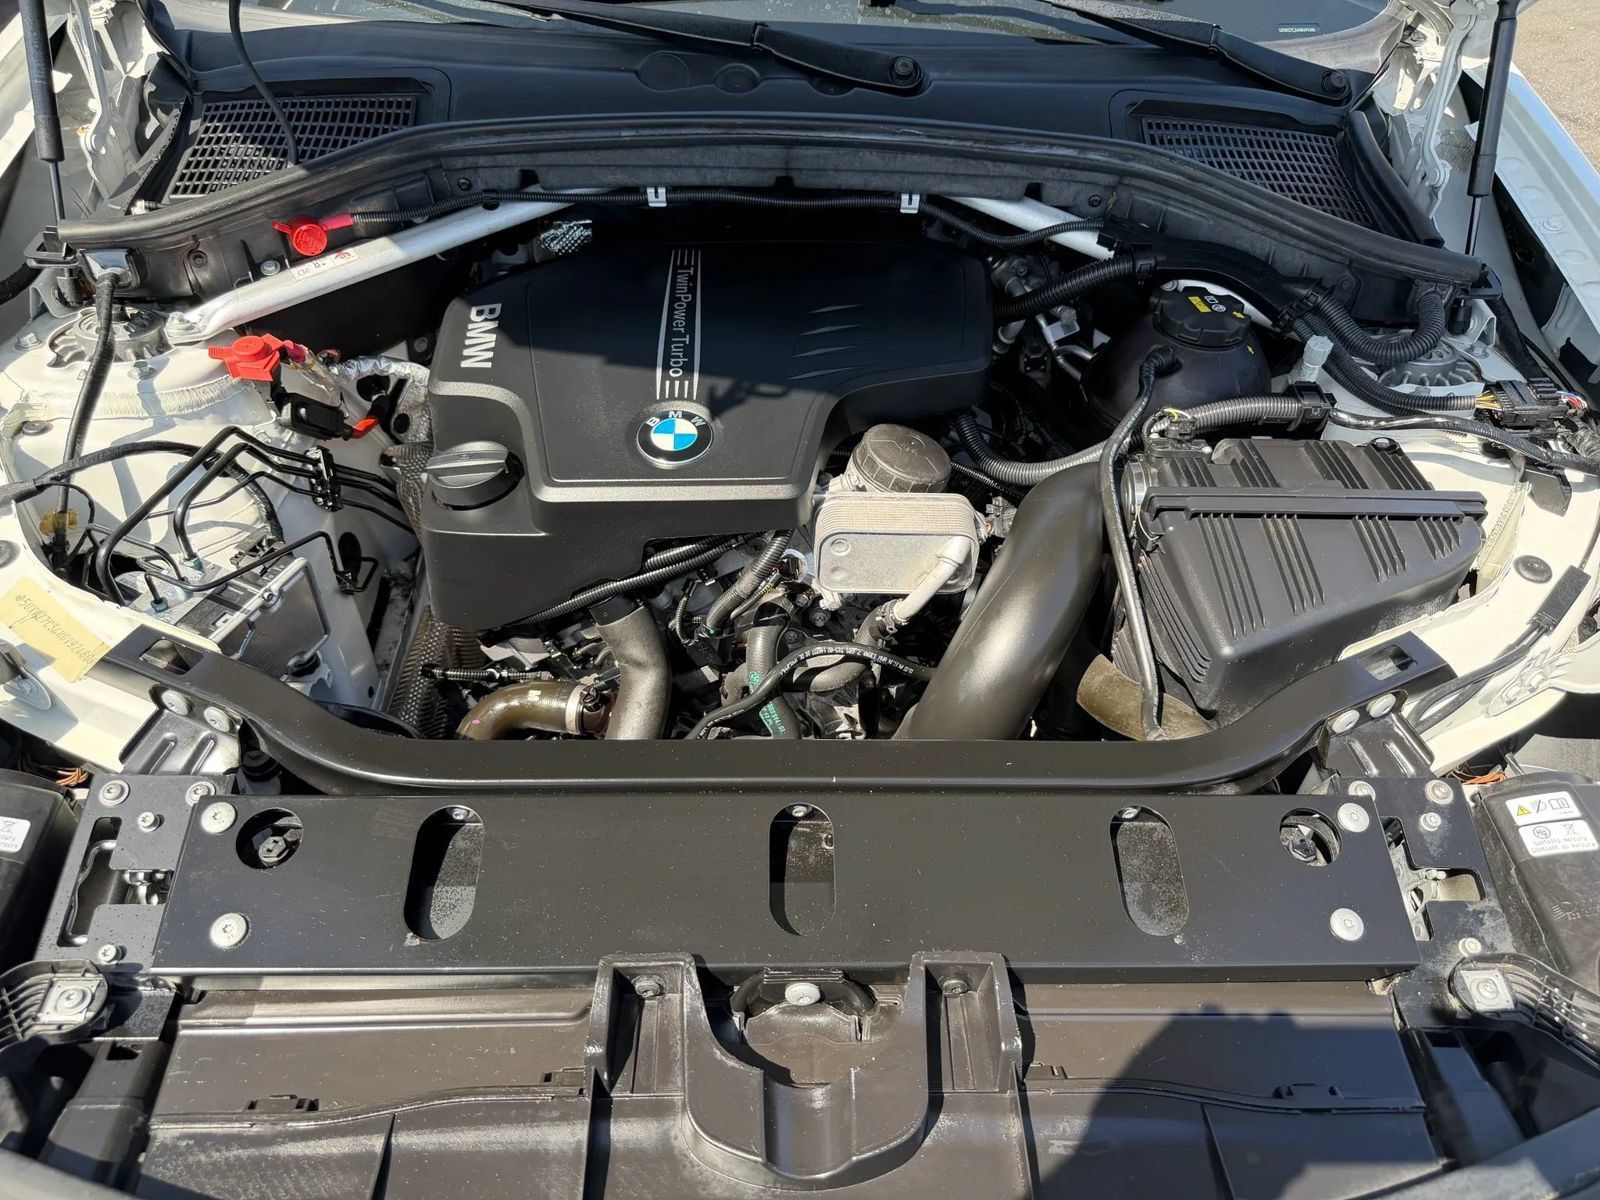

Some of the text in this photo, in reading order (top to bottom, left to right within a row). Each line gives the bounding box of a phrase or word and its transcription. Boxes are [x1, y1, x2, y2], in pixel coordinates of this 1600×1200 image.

[460, 303, 502, 368] BMW
[669, 267, 694, 378] TwinPower Turbo
[646, 410, 706, 427] BMW
[1535, 828, 1548, 838] Hg
